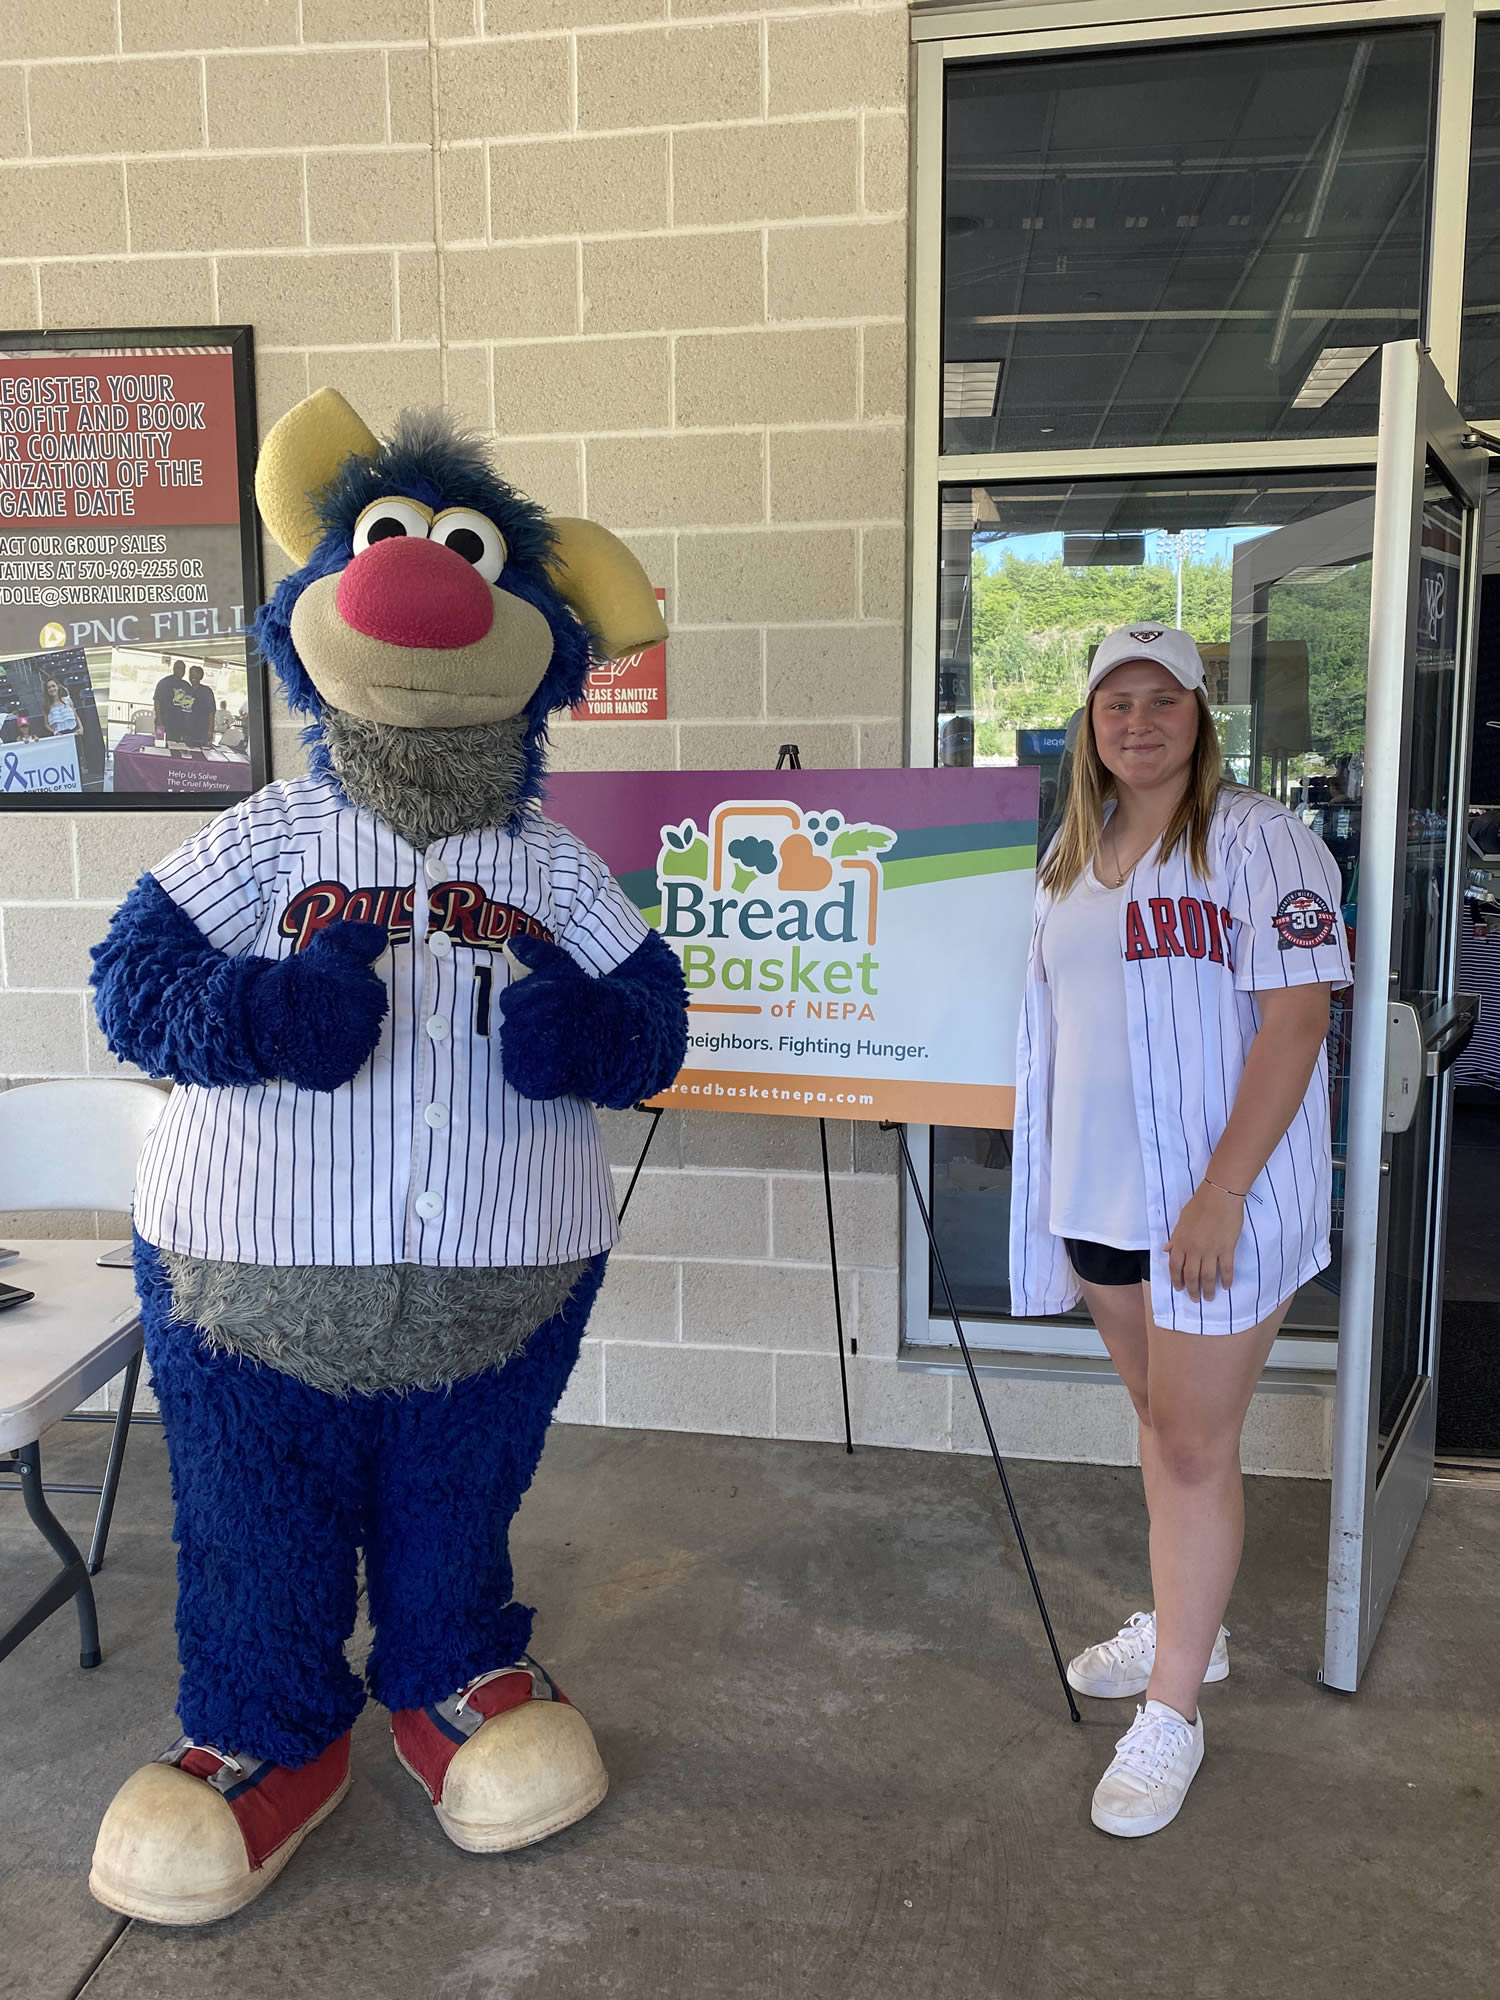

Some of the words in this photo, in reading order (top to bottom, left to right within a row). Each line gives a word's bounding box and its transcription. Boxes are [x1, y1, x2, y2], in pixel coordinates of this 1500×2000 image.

[0, 377, 101, 405] EGISTER
[107, 375, 175, 402] YOUR
[78, 404, 128, 431] AND
[137, 403, 206, 430] BOOK
[0, 434, 20, 461] R
[28, 432, 171, 460] COMMUNITY
[0, 461, 108, 489] NIZATION
[117, 460, 147, 487] OF
[156, 460, 203, 486] THE
[0, 490, 66, 517] GAME
[75, 490, 135, 516] DATE
[0, 536, 26, 555] ACT
[29, 536, 61, 555] OUR
[65, 536, 116, 554] GROUP
[121, 535, 166, 553] SALES
[57, 562, 76, 580] AT
[78, 560, 177, 579] 570-969-2255
[182, 559, 203, 578] OR
[0, 585, 207, 607] DOLE@SWBRAILRIDERS.COM
[69, 616, 140, 646] PNC
[580, 688, 613, 701] LEASE
[614, 688, 658, 700] SANITIZE
[587, 701, 613, 714] YOUR
[614, 701, 648, 714] HANDS
[167, 778, 181, 786] The
[168, 770, 186, 779] Help
[187, 771, 197, 779] Us
[661, 880, 858, 943] Bread
[1291, 911, 1318, 930] 30
[682, 945, 879, 996] Basket
[473, 964, 493, 1038] 1
[771, 1000, 795, 1018] of
[806, 1000, 876, 1022] NEPA
[686, 1032, 773, 1052] neighbors.
[778, 1036, 851, 1058] Fighting
[857, 1040, 929, 1061] Hunger.
[661, 1083, 874, 1105] readbasketnepa.com
